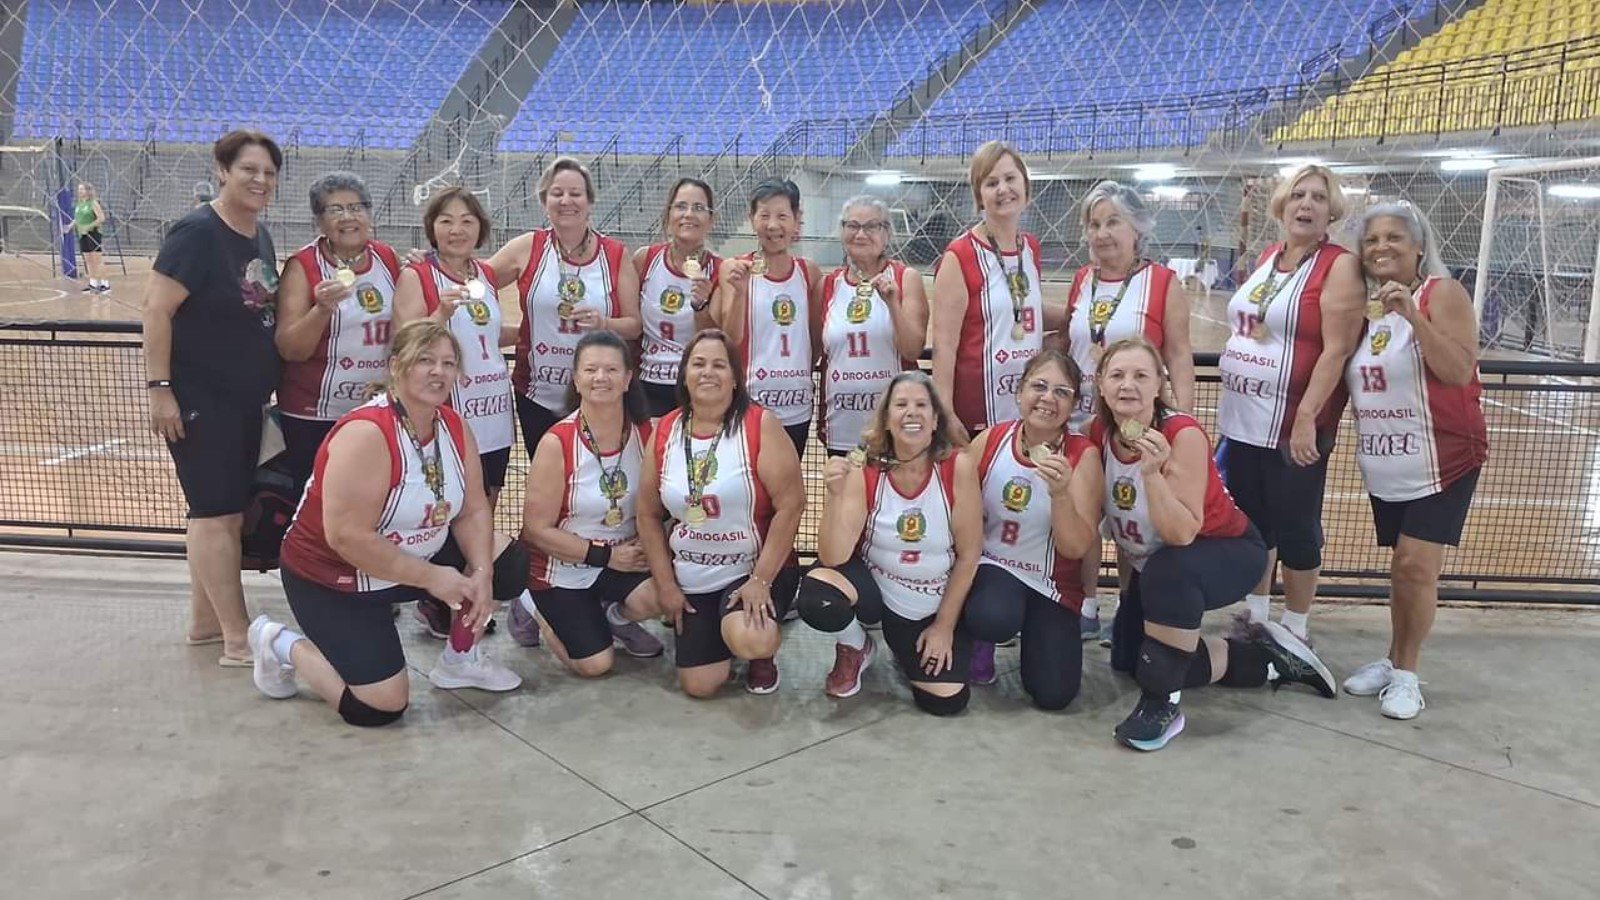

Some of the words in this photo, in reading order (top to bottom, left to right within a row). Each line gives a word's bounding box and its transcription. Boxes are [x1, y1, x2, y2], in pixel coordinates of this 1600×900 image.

[362, 320, 391, 346] 10
[779, 333, 791, 358] 1
[846, 331, 871, 358] 11
[478, 334, 490, 361] 1
[842, 369, 892, 381] DROGASIL
[1221, 370, 1275, 400] EMEL
[1360, 365, 1387, 393] 13
[464, 394, 511, 420] SEME
[1360, 432, 1420, 456] EMEL
[688, 529, 748, 542] DROGASIL
[1001, 520, 1020, 546] 8
[1114, 516, 1144, 545] 14
